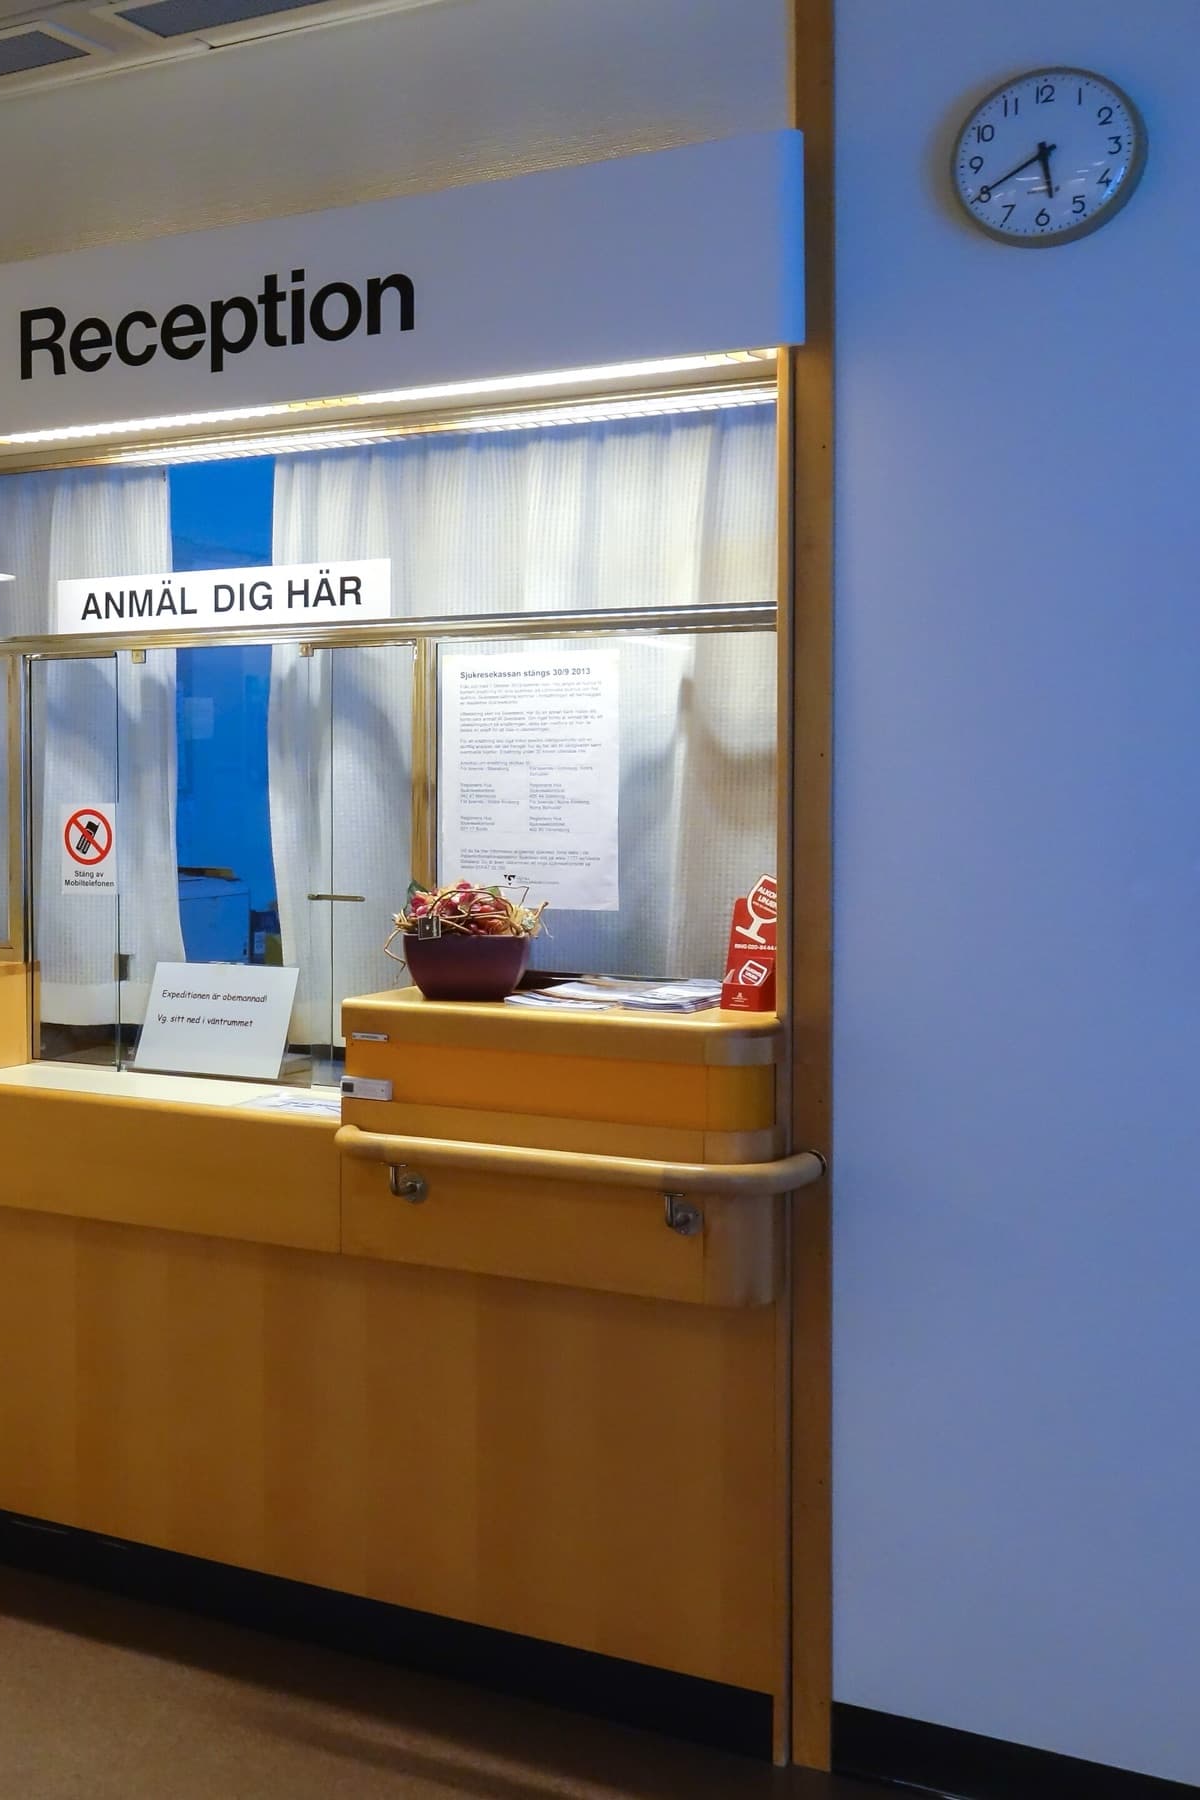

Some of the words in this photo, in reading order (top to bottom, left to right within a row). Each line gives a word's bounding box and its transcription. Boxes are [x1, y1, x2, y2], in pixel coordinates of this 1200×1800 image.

[1035, 84, 1055, 104] 12
[1077, 88, 1082, 105] 1
[1003, 97, 1018, 117] 11
[1097, 106, 1113, 125] 2
[976, 124, 995, 143] 10
[1107, 136, 1122, 154] 3
[969, 156, 984, 174] 9
[1096, 168, 1112, 187] 4
[979, 185, 992, 203] 8
[1002, 204, 1016, 223] 7
[1071, 195, 1086, 214] 5
[1035, 208, 1050, 226] 6
[19, 269, 415, 380] Reception
[81, 580, 197, 621] ANMÄL
[213, 581, 273, 613] DIG
[287, 569, 363, 609] HÄR
[552, 668, 569, 676] 30/9
[571, 667, 591, 675] 2013
[74, 870, 95, 879] Stäng
[162, 989, 210, 1000] Expeditionen
[212, 993, 221, 1001] är
[157, 1014, 169, 1024] Vg.
[170, 1015, 185, 1023] sitt
[186, 1016, 200, 1024] ned
[207, 1017, 254, 1027] väntrummet
